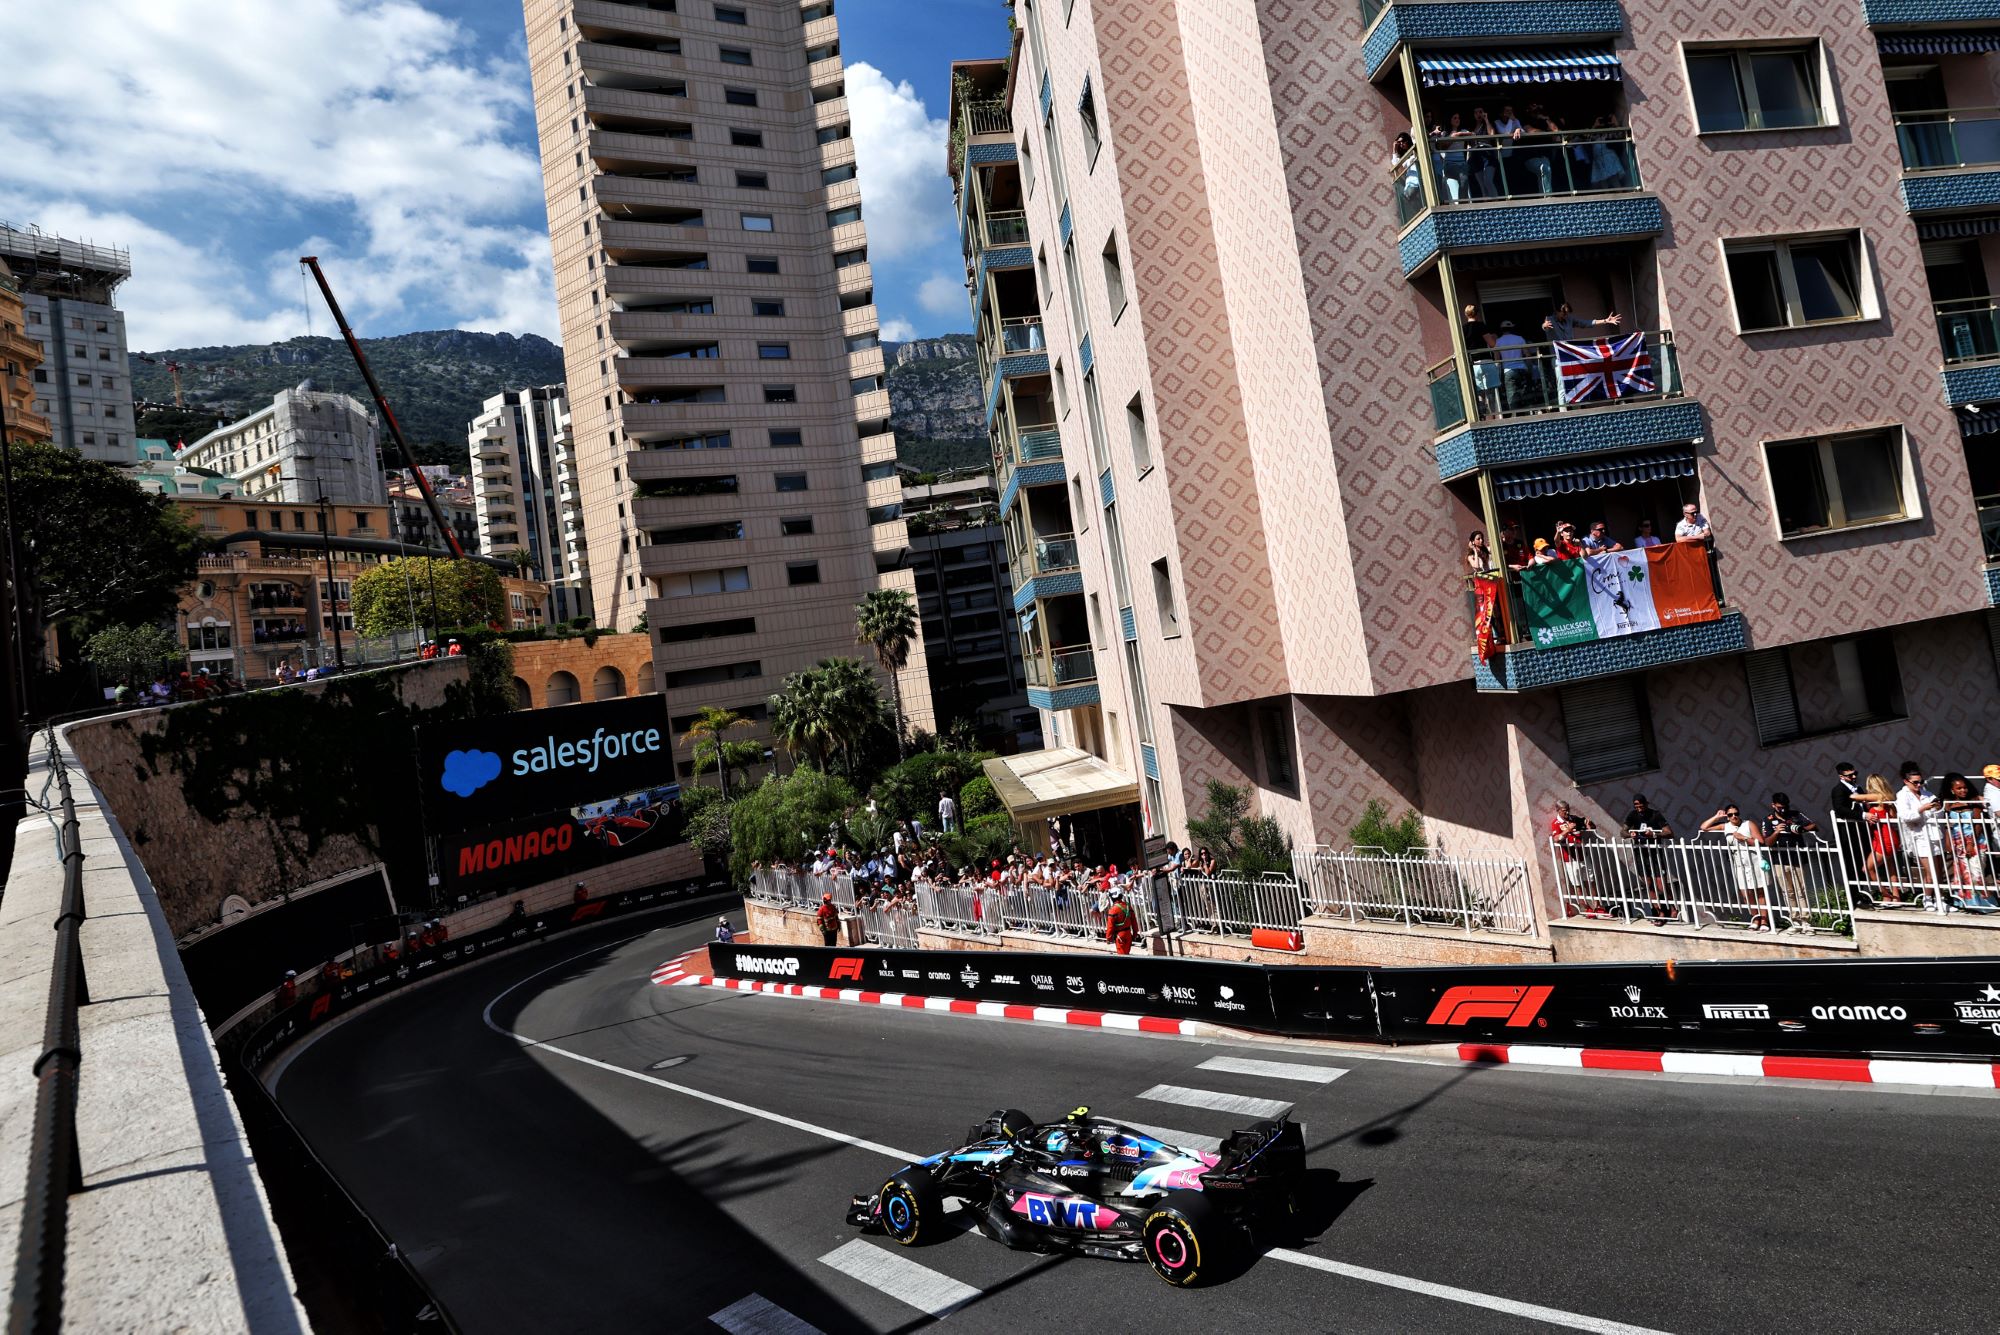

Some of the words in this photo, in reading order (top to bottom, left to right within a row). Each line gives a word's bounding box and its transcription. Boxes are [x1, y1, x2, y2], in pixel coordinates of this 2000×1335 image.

[1551, 620, 1591, 633] ELLICKSON
[512, 727, 660, 776] salesforce
[458, 823, 573, 877] MONACO
[736, 954, 800, 976] #MonacoGP
[878, 969, 895, 977] ROLEX
[928, 971, 951, 980] aramco
[993, 974, 1016, 984] DHL
[1030, 974, 1053, 985] QATAR
[1066, 975, 1084, 987] aws
[1107, 984, 1146, 995] crypto.com
[1171, 986, 1197, 1000] MSC
[1213, 1000, 1246, 1012] salesforce
[1609, 1005, 1668, 1019] ROLEX
[1702, 1004, 1771, 1020] PIRELLI
[1811, 1004, 1907, 1021] aramco
[1092, 1128, 1121, 1136] E-TECH
[1241, 1114, 1287, 1162] ALPINE
[1109, 1143, 1140, 1158] Castrol
[1067, 1167, 1089, 1177] ApeCoin
[1027, 1196, 1098, 1230] BWT
